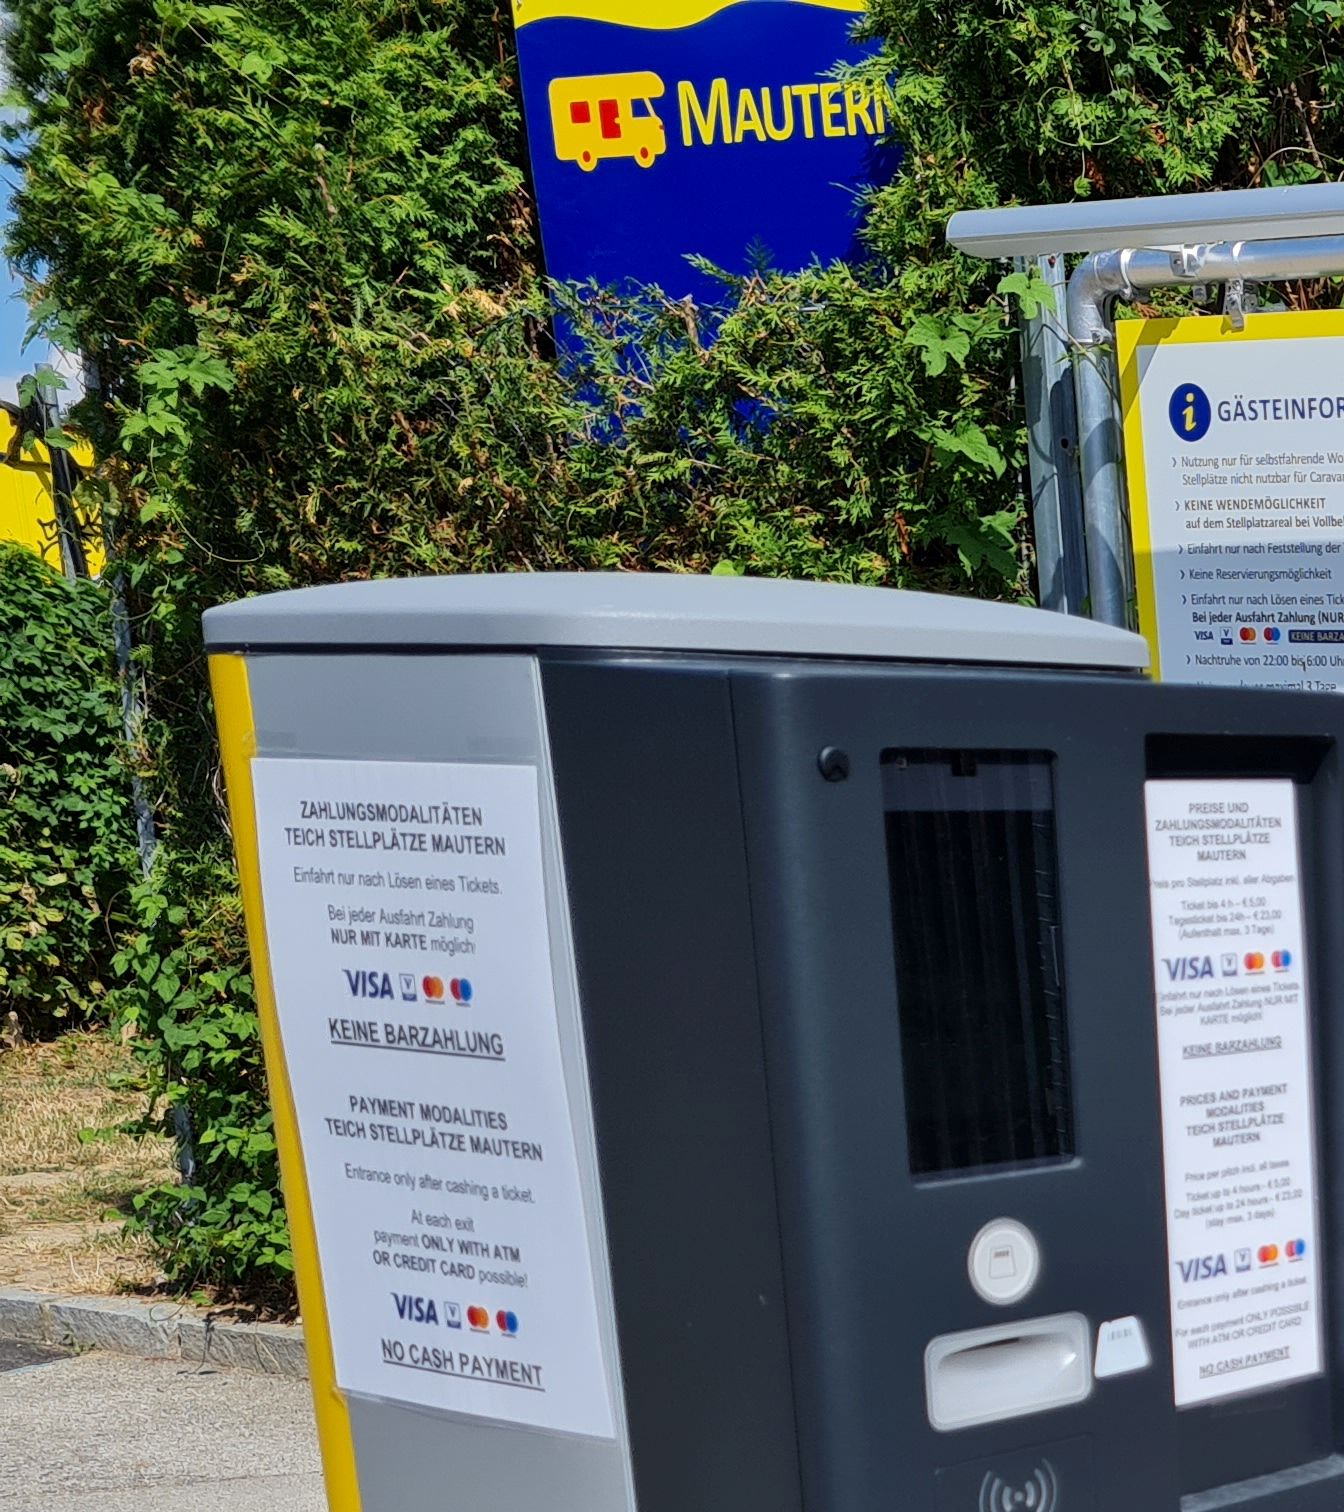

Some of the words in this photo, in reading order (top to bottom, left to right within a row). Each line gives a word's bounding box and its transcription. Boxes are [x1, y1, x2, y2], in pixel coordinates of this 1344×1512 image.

[1185, 500, 1213, 511] KEINE
[1216, 496, 1326, 510] WENDEMÖGLICHKEIT
[1186, 518, 1200, 529] auf
[1203, 518, 1224, 528] dem
[1226, 517, 1293, 530] Stellplatzareal
[1295, 516, 1310, 527] bei
[1192, 612, 1206, 623] Bei
[1208, 612, 1232, 625] jeder
[1235, 612, 1275, 623] Ausfahrt
[1277, 612, 1316, 625] Zahlung
[300, 800, 482, 826] ZAHLUNGSMODALITÄTEN
[1189, 803, 1225, 814] PREISE
[1227, 802, 1249, 813] UND
[1155, 815, 1282, 831] ZAHLUNGSMODALITÄTEN
[285, 827, 325, 847] TEICH
[329, 828, 428, 852] STELLPLÄTZE
[432, 834, 506, 856] MAUTERN
[1169, 835, 1199, 846] TEICH
[1202, 831, 1270, 845] STELLPLÄTZE
[1197, 849, 1246, 861] MAUTERN
[294, 867, 335, 884] Einfahrt
[337, 871, 354, 885] nur
[359, 872, 384, 887] nach
[388, 872, 422, 889] Lösen
[426, 875, 455, 891] eines
[458, 875, 502, 895] Tickets.
[328, 904, 346, 921] Bei
[348, 906, 376, 925] jeder
[379, 908, 425, 927] Ausfahrt
[428, 911, 474, 934] Zahlung
[331, 927, 357, 945] NUR
[361, 930, 381, 946] MIT
[385, 931, 427, 950] KARTE
[1161, 956, 1214, 981] VISA
[342, 969, 395, 1000] VISA
[328, 1017, 380, 1043] KEINE
[384, 1024, 504, 1055] BARZAHLUNG
[350, 1095, 415, 1119] PAYMENT
[420, 1103, 508, 1130] MODALITIES
[325, 1117, 366, 1138] TEICH
[370, 1123, 467, 1152] STELLPLÄTZE
[470, 1135, 543, 1161] MAUTERN
[345, 1163, 391, 1184] Entrance
[394, 1172, 416, 1191] only
[419, 1173, 443, 1189] after
[446, 1178, 489, 1201] cashing
[492, 1186, 499, 1198] a
[411, 1209, 423, 1225] At
[425, 1213, 450, 1229] each
[455, 1216, 475, 1232] exit
[374, 1230, 419, 1247] payment
[422, 1234, 454, 1253] ONLY
[458, 1240, 490, 1258] WITH
[493, 1245, 521, 1262] ATM
[373, 1250, 390, 1268] OR
[393, 1253, 437, 1274] CREDIT
[440, 1260, 475, 1280] CARD
[1175, 1254, 1228, 1284] VISA
[390, 1292, 439, 1325] VISA
[381, 1338, 404, 1362] NO
[409, 1344, 454, 1371] CASH
[459, 1352, 542, 1386] PAYMENT
